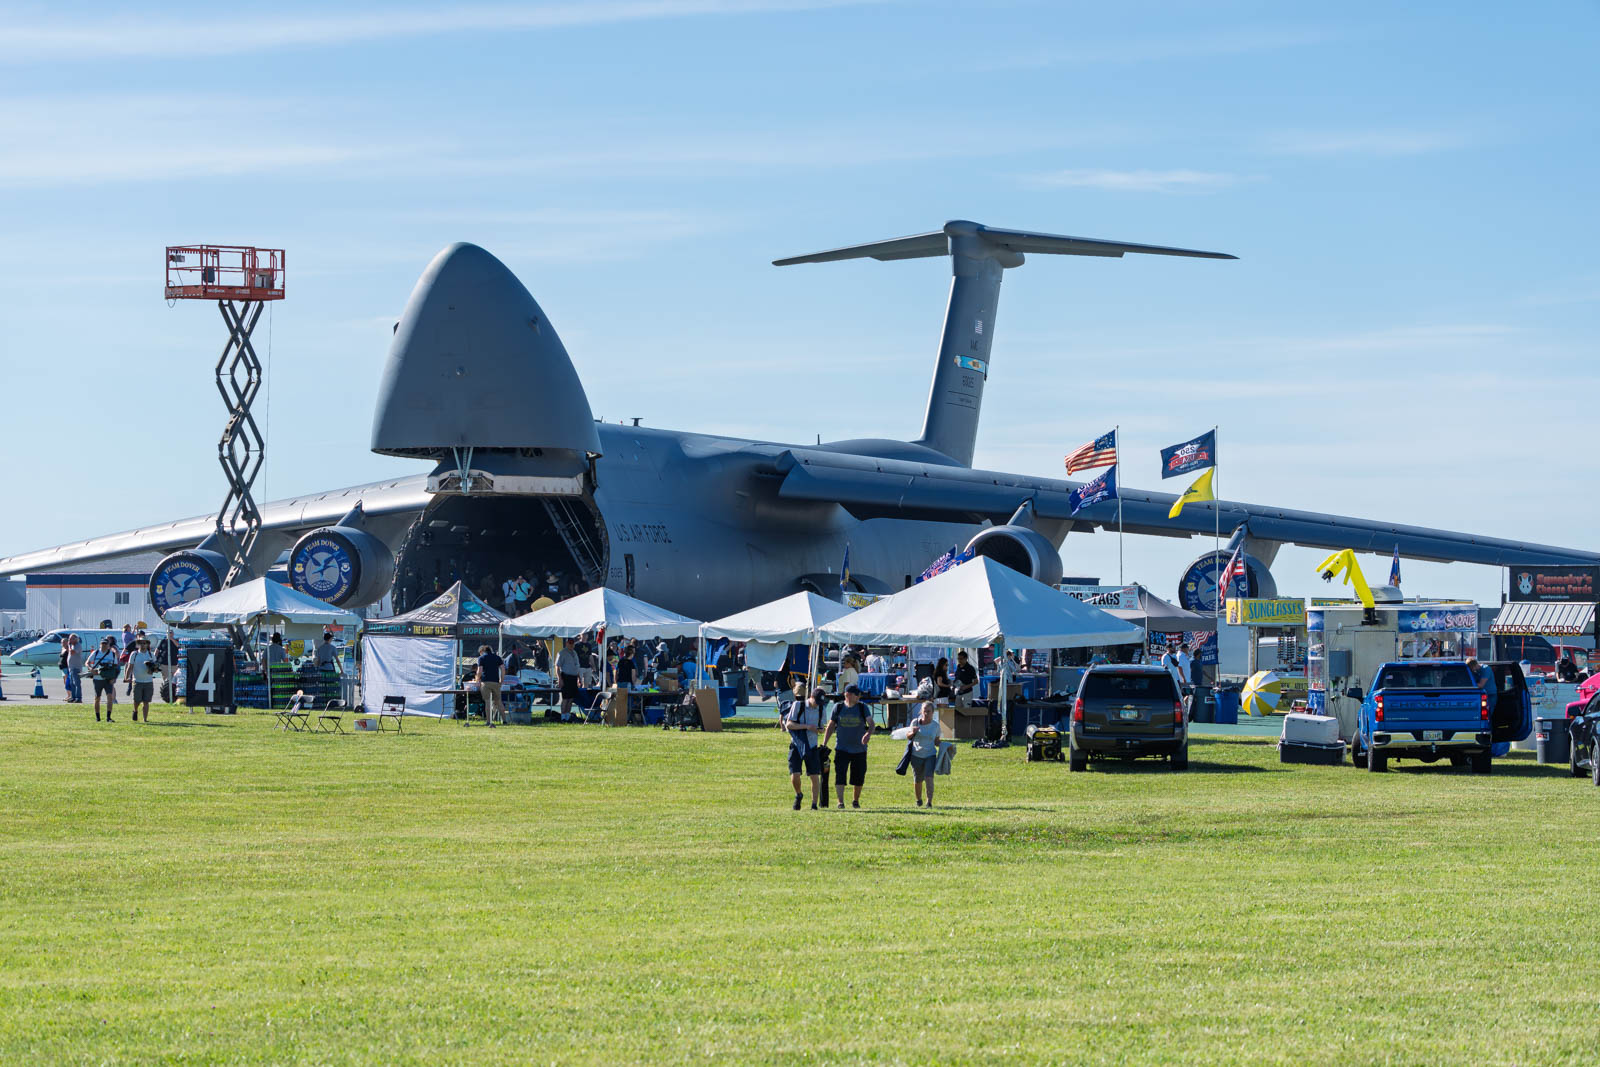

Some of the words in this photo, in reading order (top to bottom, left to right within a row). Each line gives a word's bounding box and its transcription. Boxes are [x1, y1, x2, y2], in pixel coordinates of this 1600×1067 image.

[629, 523, 643, 543] AIR
[642, 524, 673, 544] FORCE
[305, 540, 320, 552] TEAM
[320, 539, 340, 552] DOVER
[165, 562, 180, 574] TEAM
[180, 561, 201, 573] DOVER
[1195, 557, 1214, 570] TEAM
[1091, 592, 1121, 606] TAGS
[1248, 602, 1303, 620] SUNGLASSES
[1445, 612, 1477, 629] SNOWIE
[368, 623, 386, 633] HOPE
[421, 625, 433, 635] LIGHT
[434, 626, 449, 635] 93.7
[463, 627, 482, 635] HOPE
[1488, 623, 1536, 636] CHEESE
[1540, 623, 1583, 636] CURDS
[194, 653, 217, 703] 4
[1389, 701, 1474, 709] CHEVROLET
